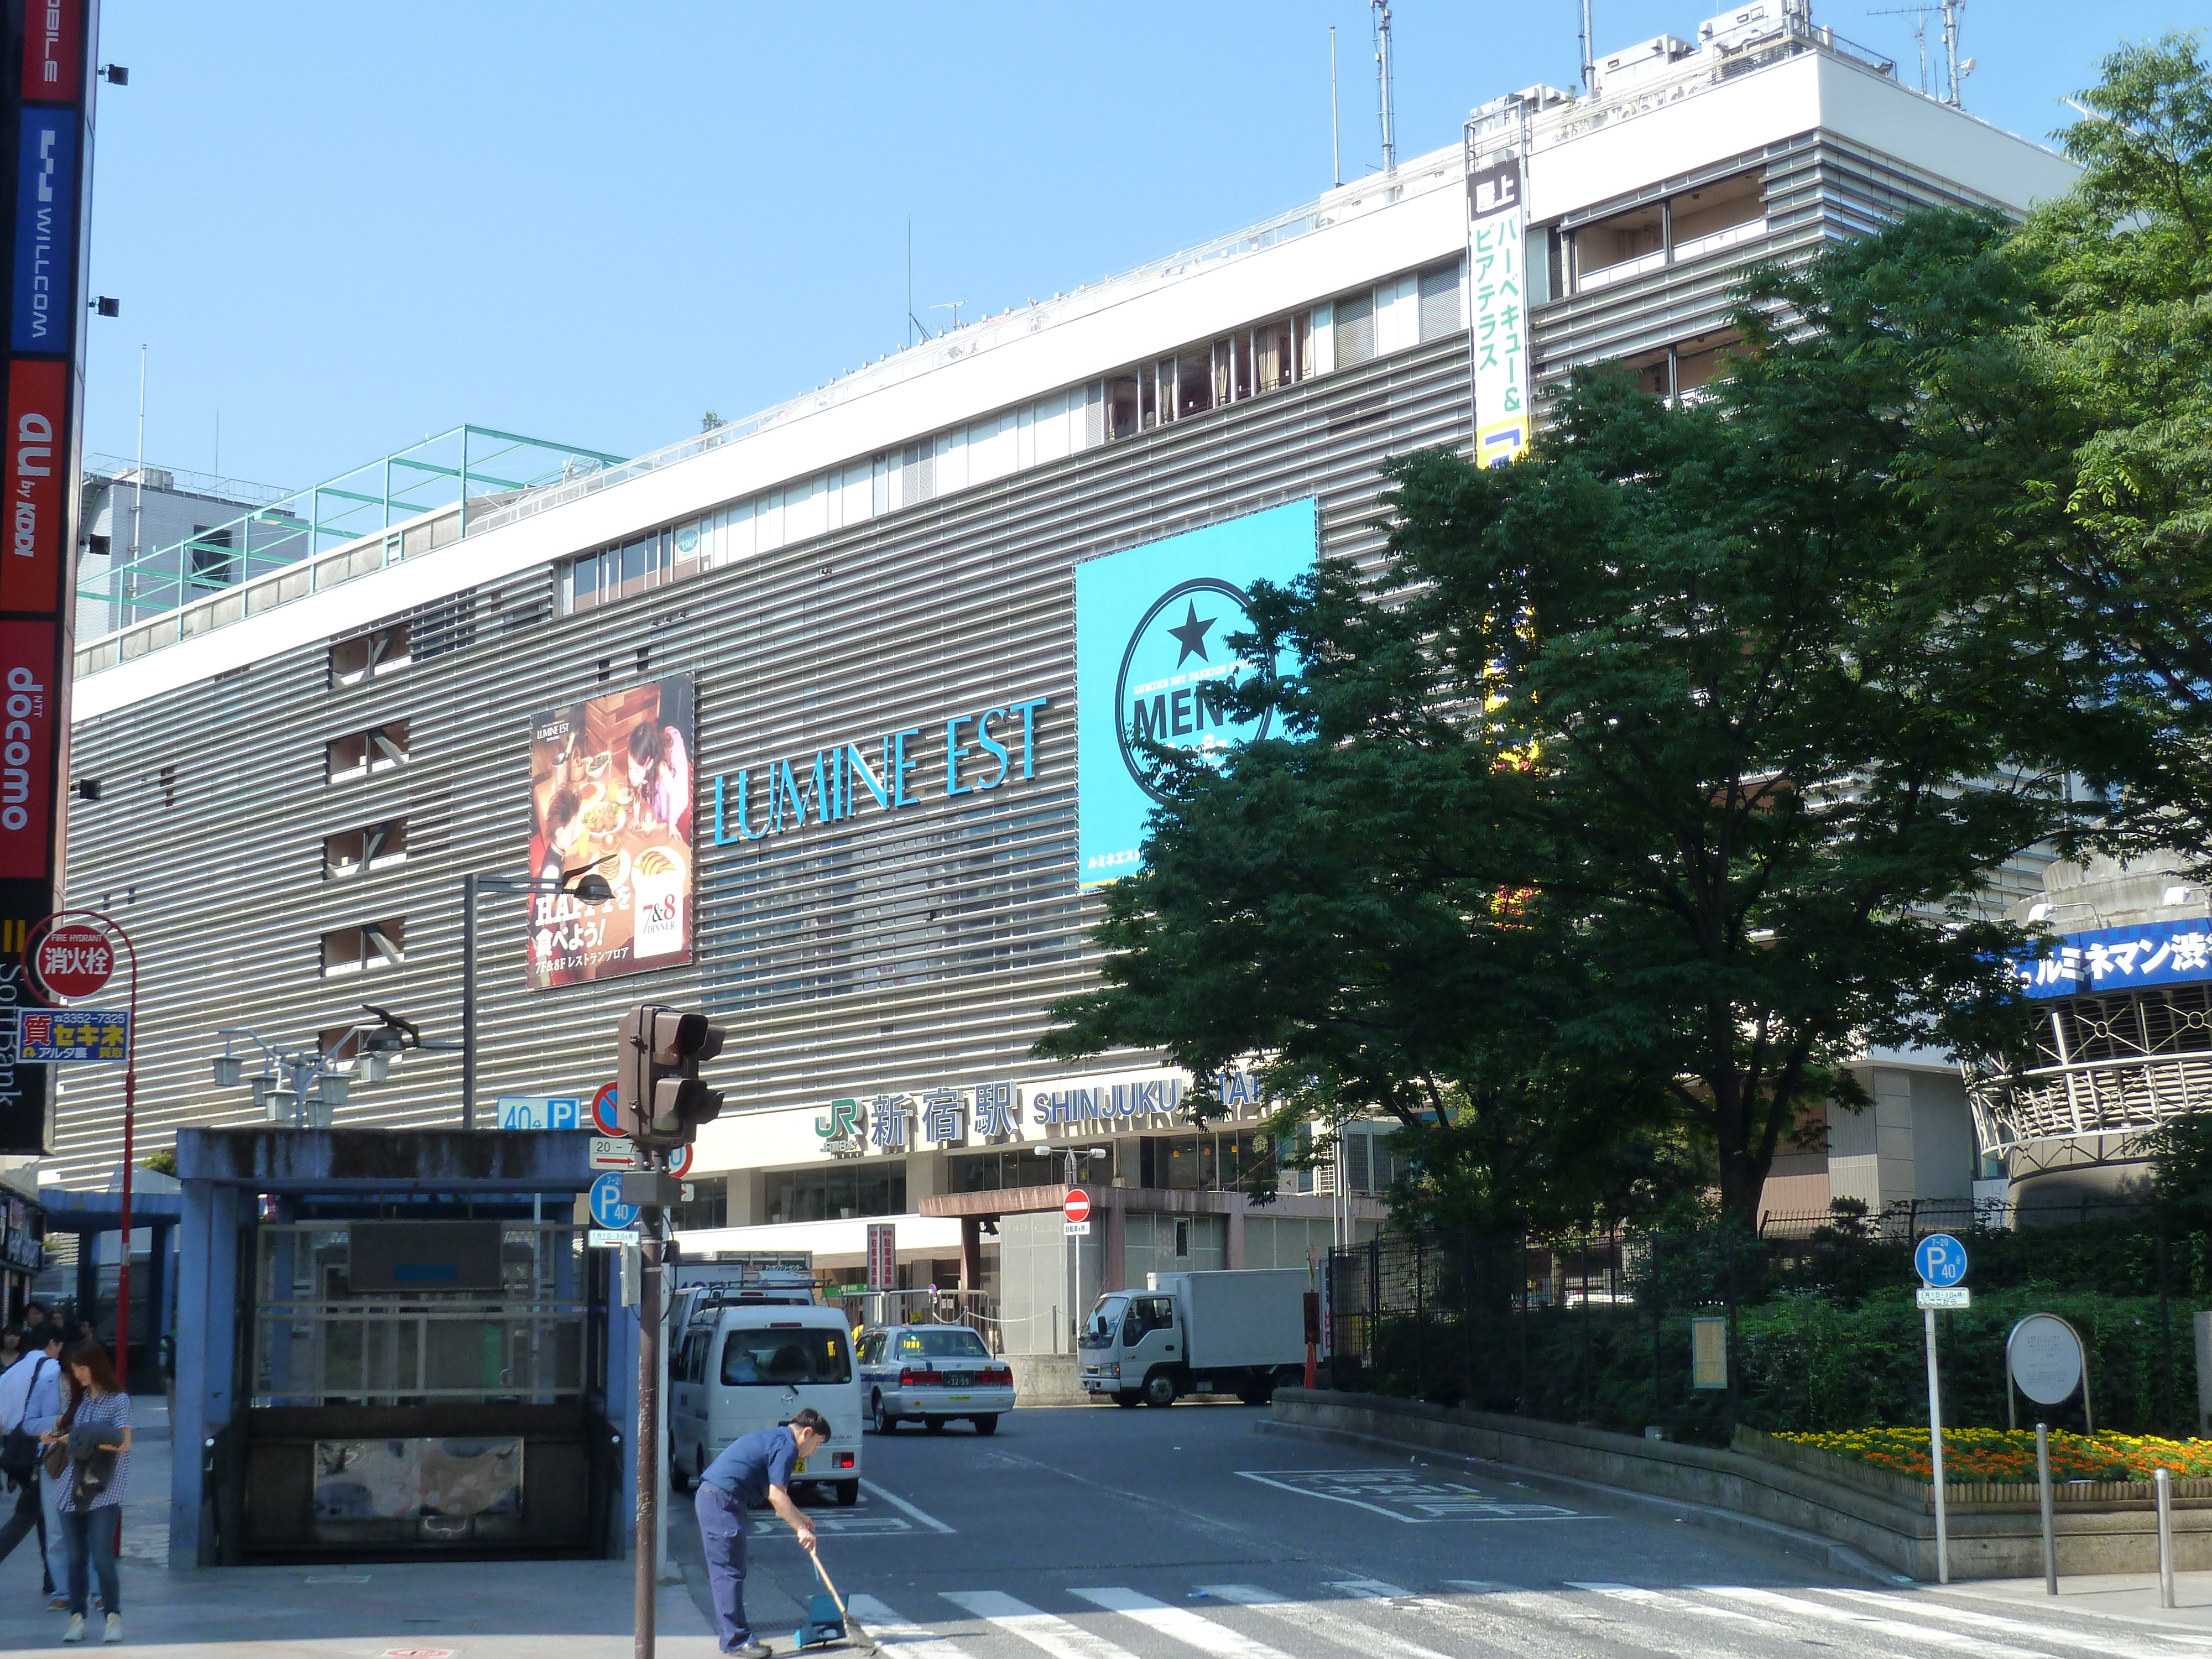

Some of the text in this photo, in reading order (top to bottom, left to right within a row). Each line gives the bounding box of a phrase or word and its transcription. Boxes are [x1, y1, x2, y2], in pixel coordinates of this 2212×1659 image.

[33, 207, 52, 337] WILLCOM
[1476, 222, 1498, 371] ビアテラス
[14, 413, 53, 557] au by KDDI
[1134, 679, 1168, 695] LUMINE
[1170, 674, 1186, 686] EST
[33, 695, 43, 717] NTT
[2, 667, 44, 831] docomo
[714, 697, 1047, 846] LUMINE EST
[643, 894, 675, 935] 7&8
[648, 922, 675, 934] DINNER
[70, 933, 102, 942] HYDRANT
[44, 947, 109, 975] 消火栓
[23, 1014, 51, 1046] 質
[53, 1023, 124, 1047] セキネ
[99, 1046, 123, 1058] 買取
[554, 1103, 572, 1129] P
[815, 1097, 858, 1138] JR
[870, 1081, 1018, 1147] 新宿駅
[1033, 1077, 1179, 1126] SHINJUKU
[601, 1185, 620, 1220] P
[614, 1204, 629, 1220] 40
[1932, 1238, 1949, 1246] 7-20
[1927, 1246, 1947, 1279] P
[1942, 1264, 1956, 1279] 40
